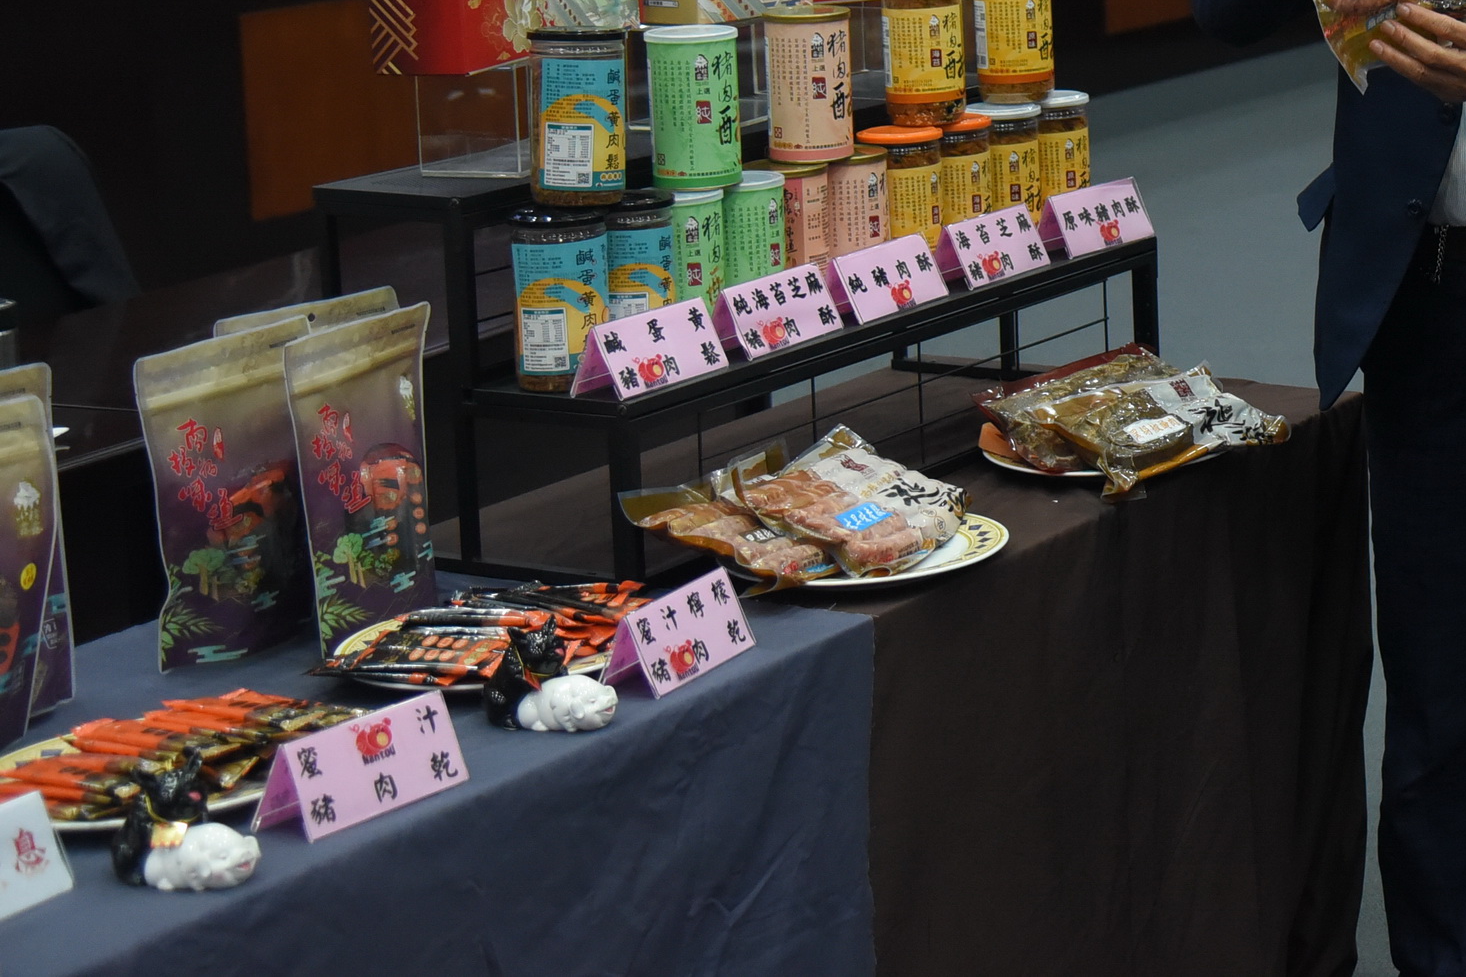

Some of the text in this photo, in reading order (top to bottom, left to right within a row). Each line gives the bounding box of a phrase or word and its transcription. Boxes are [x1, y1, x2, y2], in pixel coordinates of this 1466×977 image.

[955, 212, 1032, 250] 海苔芝麻
[1062, 196, 1141, 232] 原味豬肉酥
[732, 272, 824, 317] 純海苔芝麻
[848, 252, 934, 295] 純豬肉酥
[636, 582, 731, 645] 蜜汁檸檬
